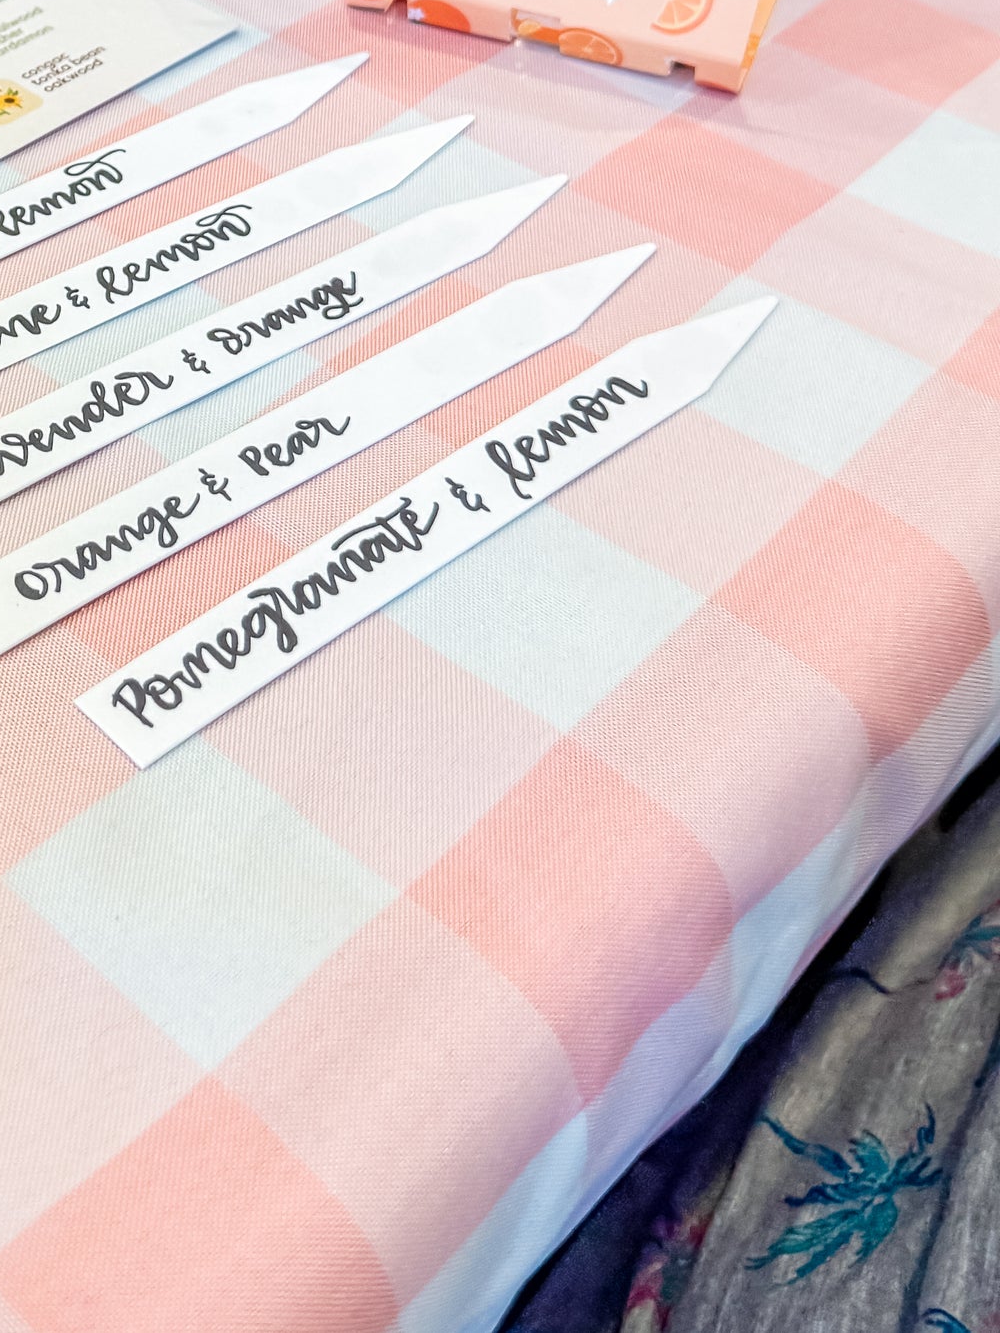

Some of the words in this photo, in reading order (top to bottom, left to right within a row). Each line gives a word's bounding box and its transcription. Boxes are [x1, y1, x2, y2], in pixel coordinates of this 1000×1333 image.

[31, 63, 72, 87] tonka
[69, 45, 107, 67] bean
[44, 58, 104, 93] oakwood
[64, 285, 91, 310] &
[97, 204, 253, 304] lemon
[181, 348, 211, 375] &
[198, 467, 232, 502] &
[237, 415, 351, 477] Pear
[110, 496, 440, 730] Pomegranate
[449, 477, 493, 514] &
[485, 374, 649, 502] lemon
